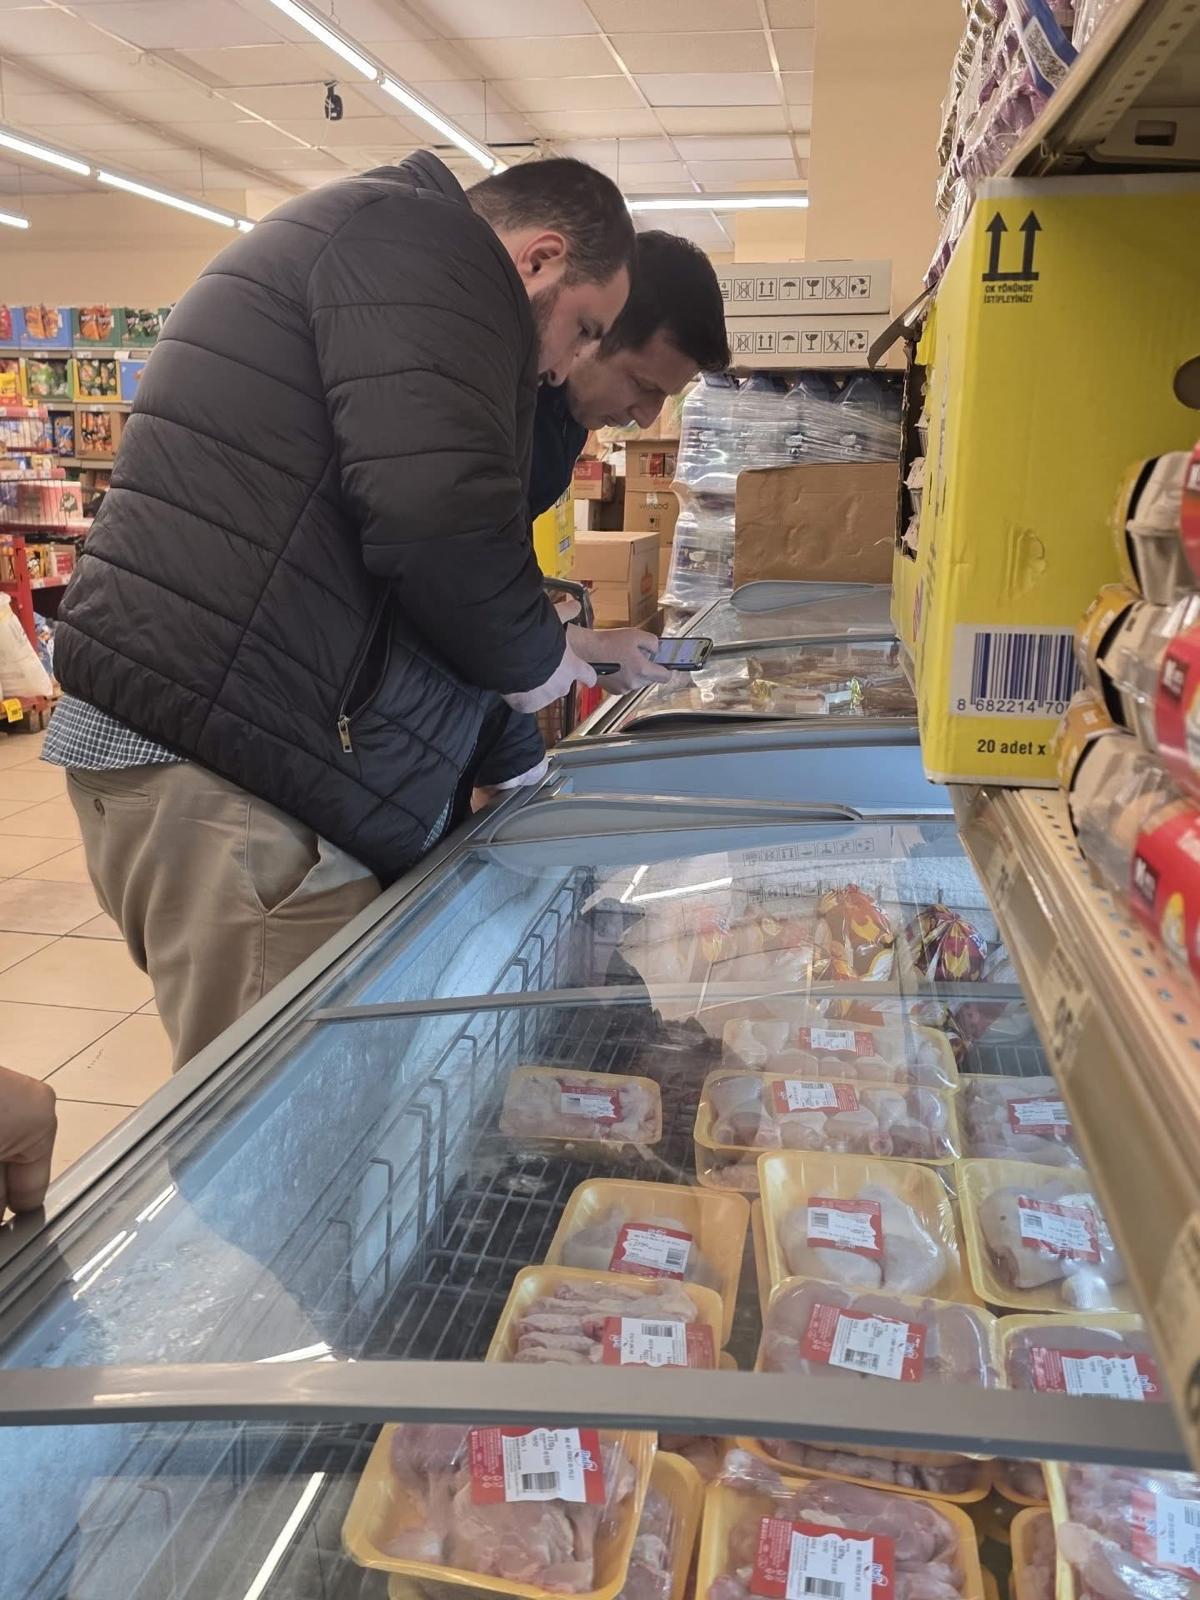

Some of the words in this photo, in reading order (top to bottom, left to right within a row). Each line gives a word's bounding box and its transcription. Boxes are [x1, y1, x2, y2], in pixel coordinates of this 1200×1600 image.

[957, 698, 966, 711] 8
[976, 699, 1035, 713] 682214
[977, 739, 996, 753] 20
[1000, 740, 1033, 755] adet
[1037, 744, 1046, 755] x
